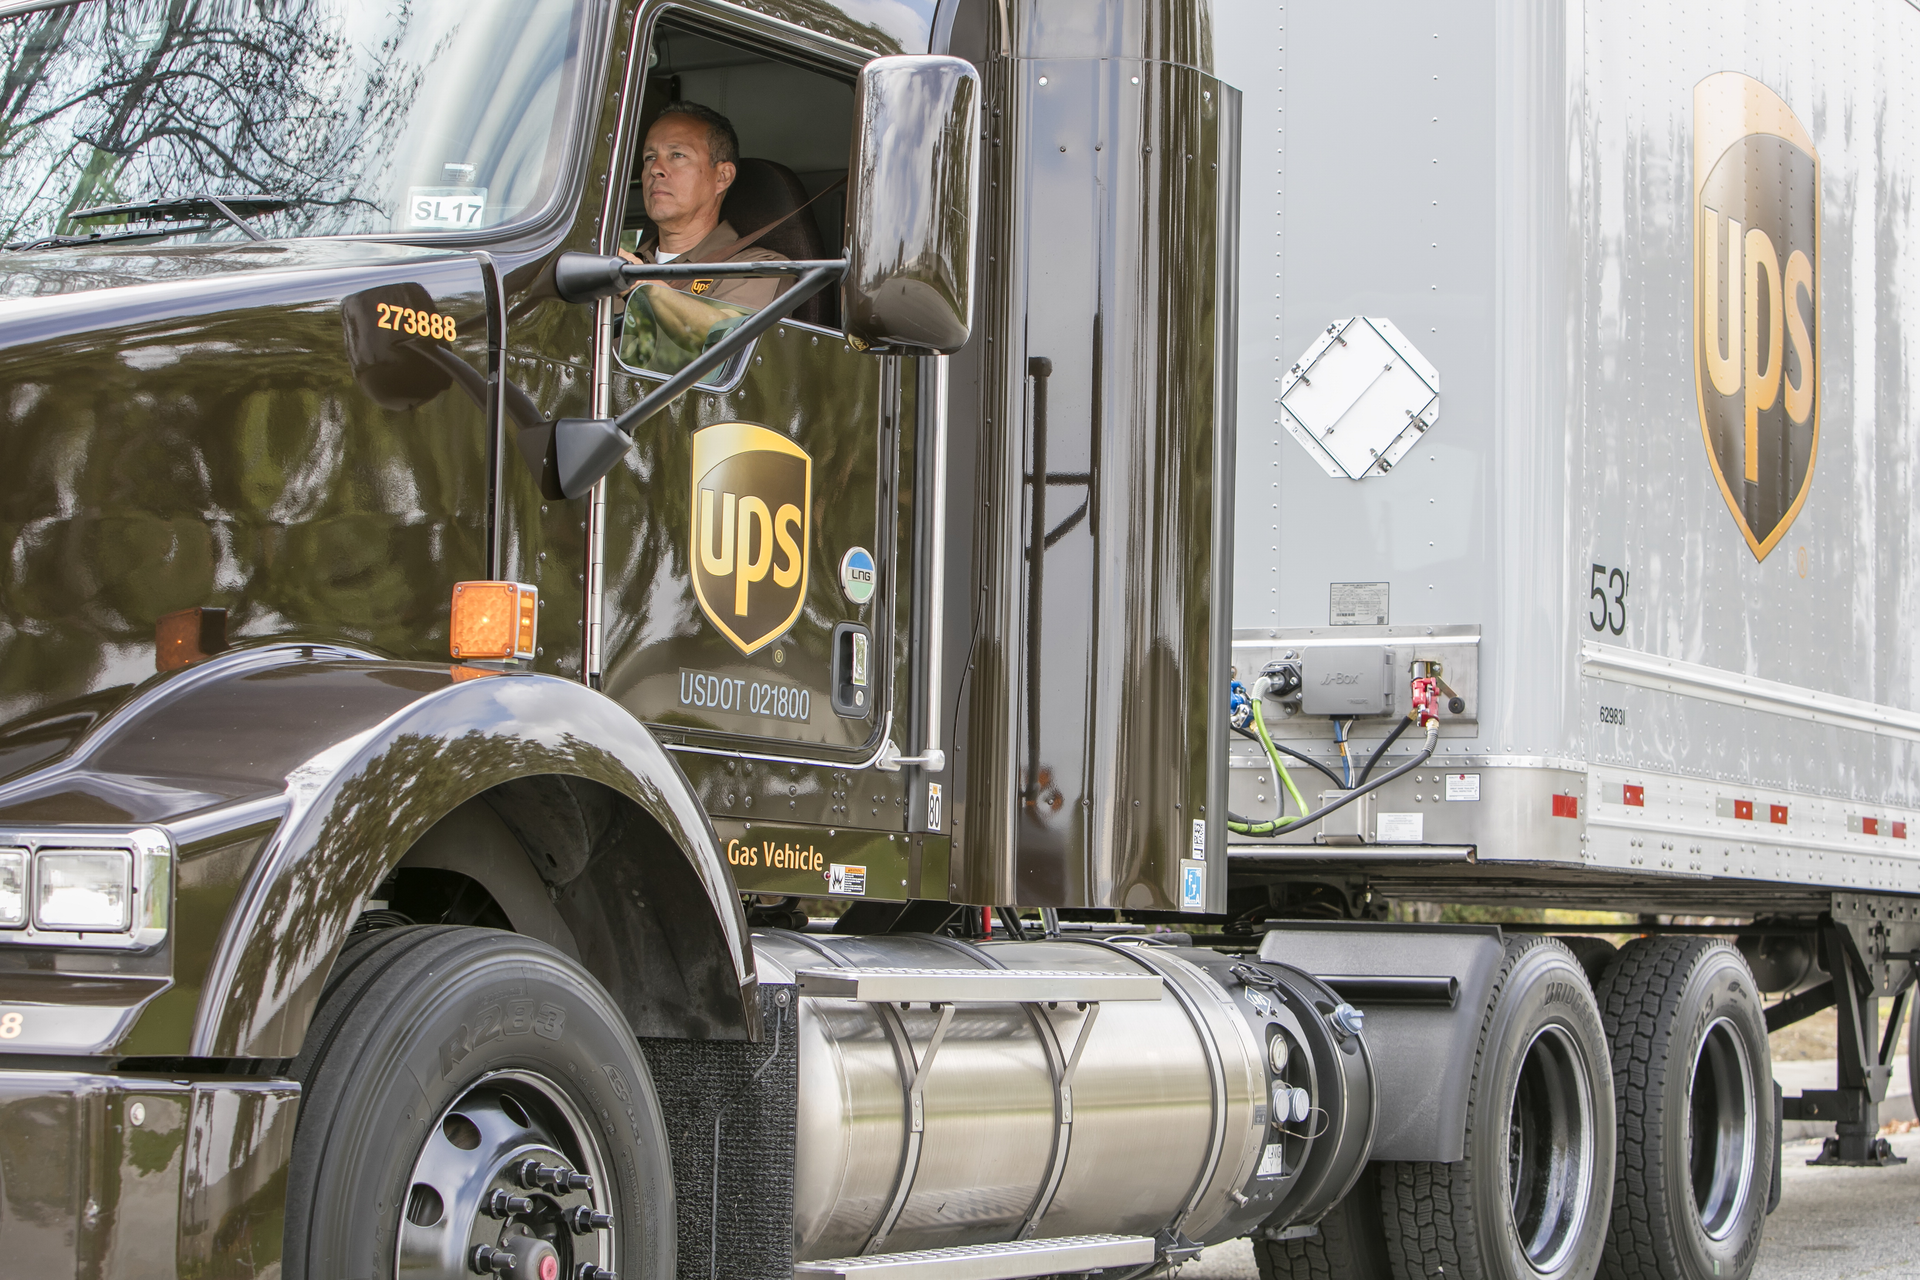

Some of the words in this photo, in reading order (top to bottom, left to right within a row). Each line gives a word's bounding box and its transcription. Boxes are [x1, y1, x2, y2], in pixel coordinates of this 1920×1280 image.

[693, 282, 710, 294] ups
[376, 302, 457, 342] 273888
[1703, 204, 1814, 485] ups
[700, 487, 802, 617] ups
[851, 569, 871, 582] LNG
[680, 671, 746, 711] USDOT
[749, 682, 810, 720] 021800
[727, 838, 758, 867] Gas
[763, 841, 824, 872] Vehicle
[0, 1011, 24, 1039] 8
[438, 998, 567, 1081] R283
[1543, 980, 1611, 1091] BRIDGESTONE
